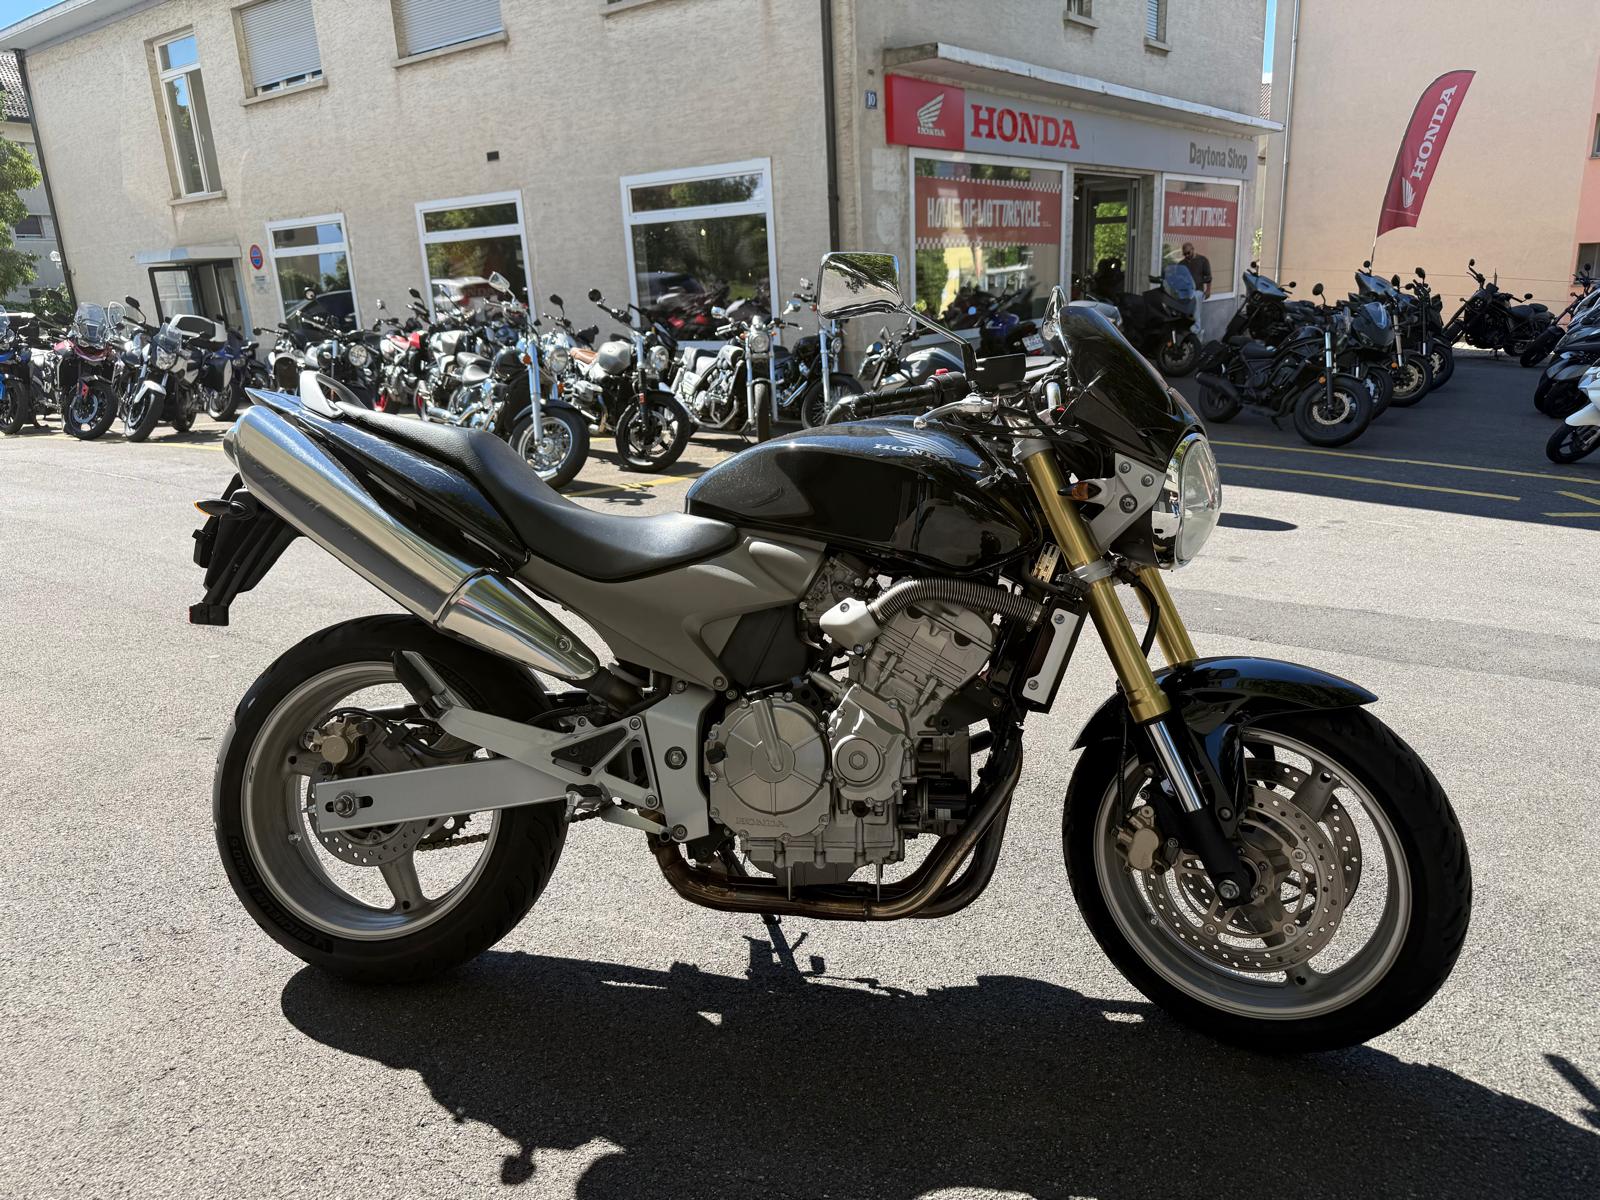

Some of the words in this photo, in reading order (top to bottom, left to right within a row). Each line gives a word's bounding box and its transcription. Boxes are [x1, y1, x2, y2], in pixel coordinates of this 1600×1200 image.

[868, 92, 876, 106] 10
[917, 126, 945, 137] HONDA
[971, 104, 1080, 149] HONDA
[1410, 85, 1457, 180] HONDA
[1189, 142, 1226, 170] Daytona
[1228, 148, 1247, 173] Shop
[963, 198, 976, 228] OF
